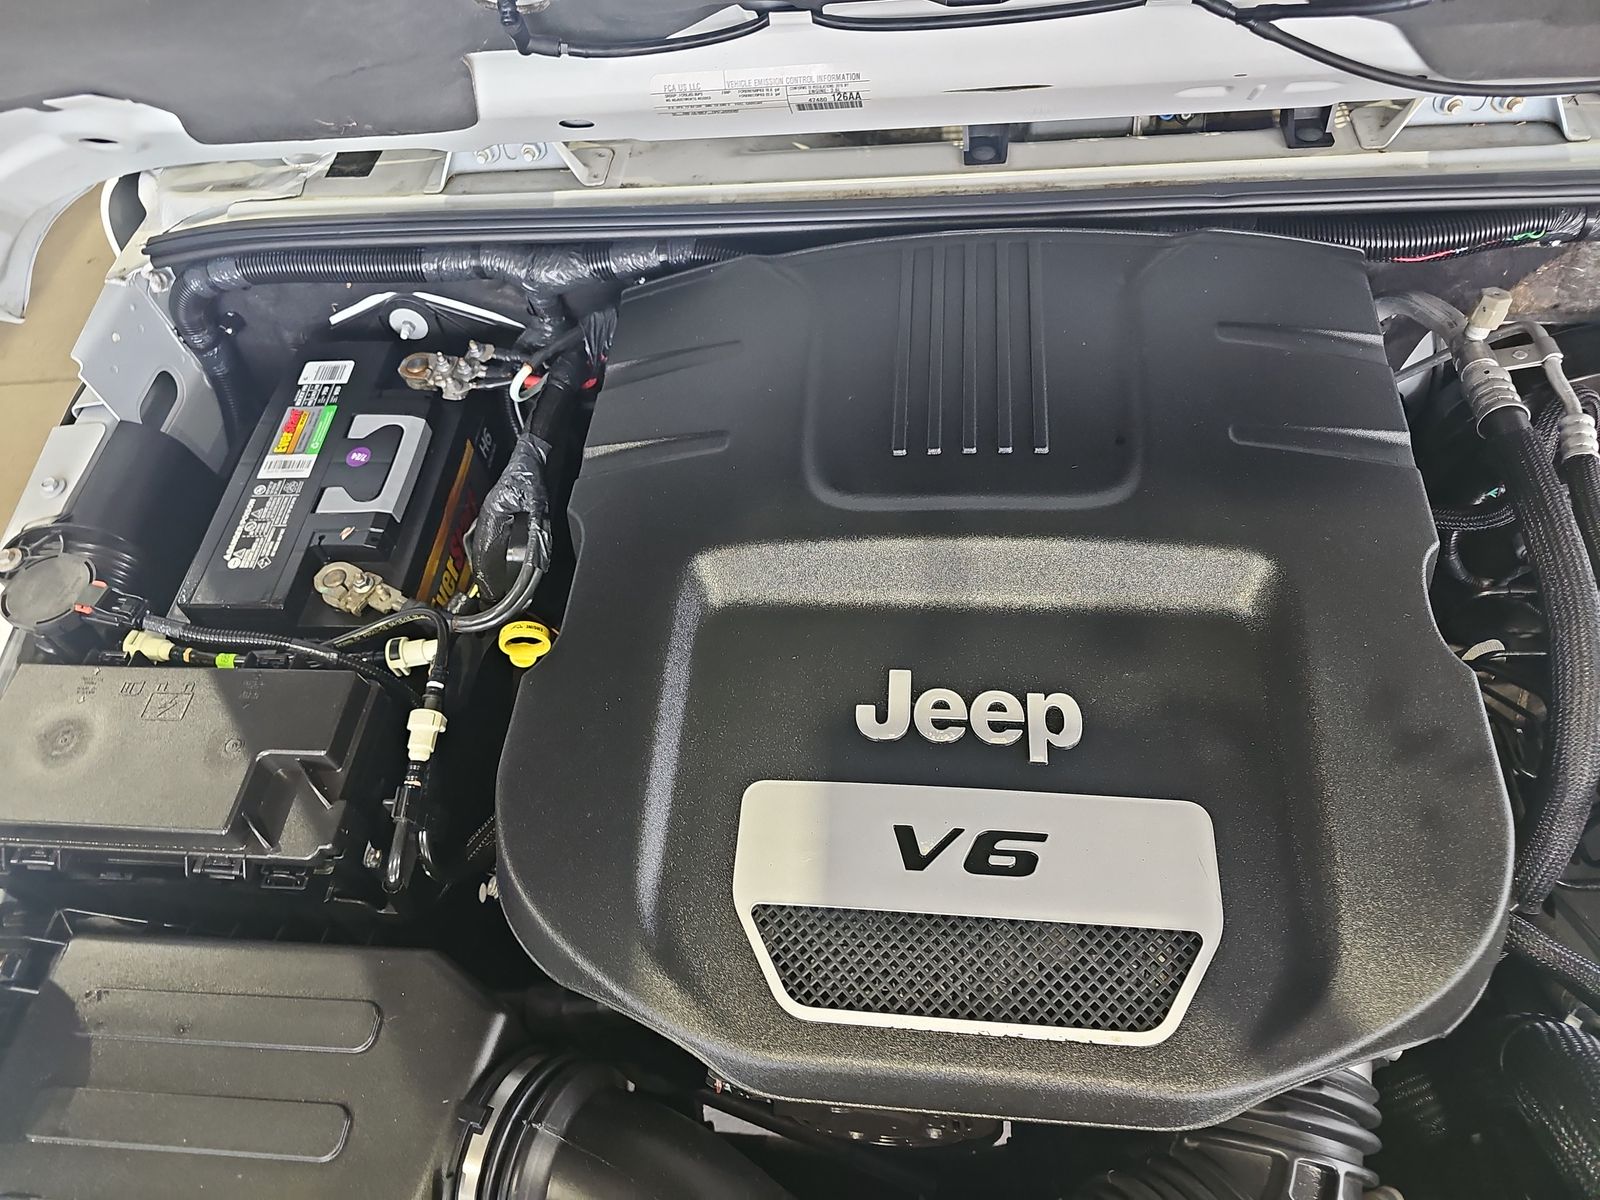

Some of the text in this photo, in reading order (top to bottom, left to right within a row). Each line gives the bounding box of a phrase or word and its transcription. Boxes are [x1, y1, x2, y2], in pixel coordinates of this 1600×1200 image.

[664, 82, 701, 92] FCA US LLC
[726, 79, 752, 88] VEHICLE
[754, 77, 784, 87] EMISSION
[786, 75, 815, 84] CONTROL
[817, 73, 861, 83] INFORMATION
[832, 91, 862, 102] 126AA
[479, 427, 493, 458] H6
[855, 669, 1082, 766] Jeep
[893, 824, 1048, 877] V6
